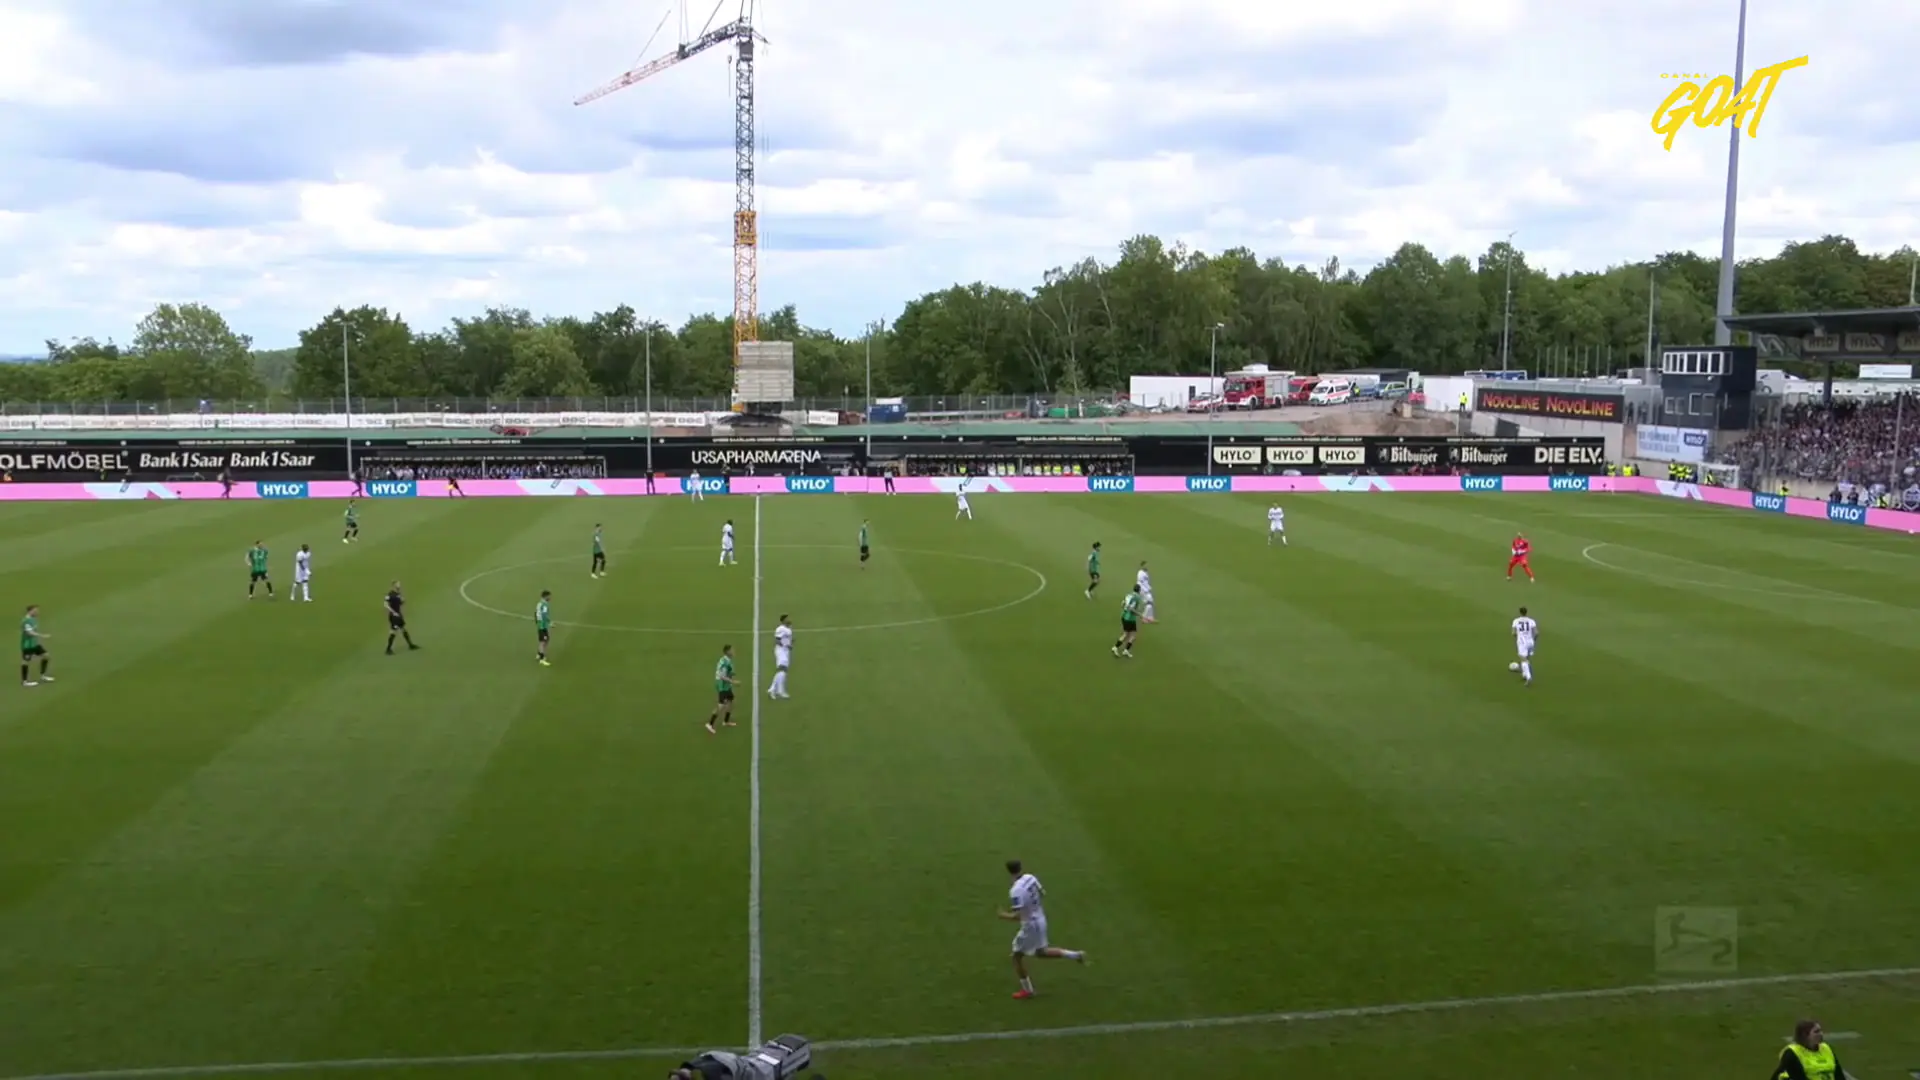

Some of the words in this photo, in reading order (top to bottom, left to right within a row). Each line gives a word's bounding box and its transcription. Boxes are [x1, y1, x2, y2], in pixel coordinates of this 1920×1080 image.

[139, 452, 224, 468] Bank1Saar
[230, 451, 316, 467] Bank1Saar
[1390, 446, 1438, 465] Bitburger
[1461, 446, 1508, 465] Bitburger
[1534, 447, 1566, 463] DIE
[1518, 621, 1530, 632] 31
